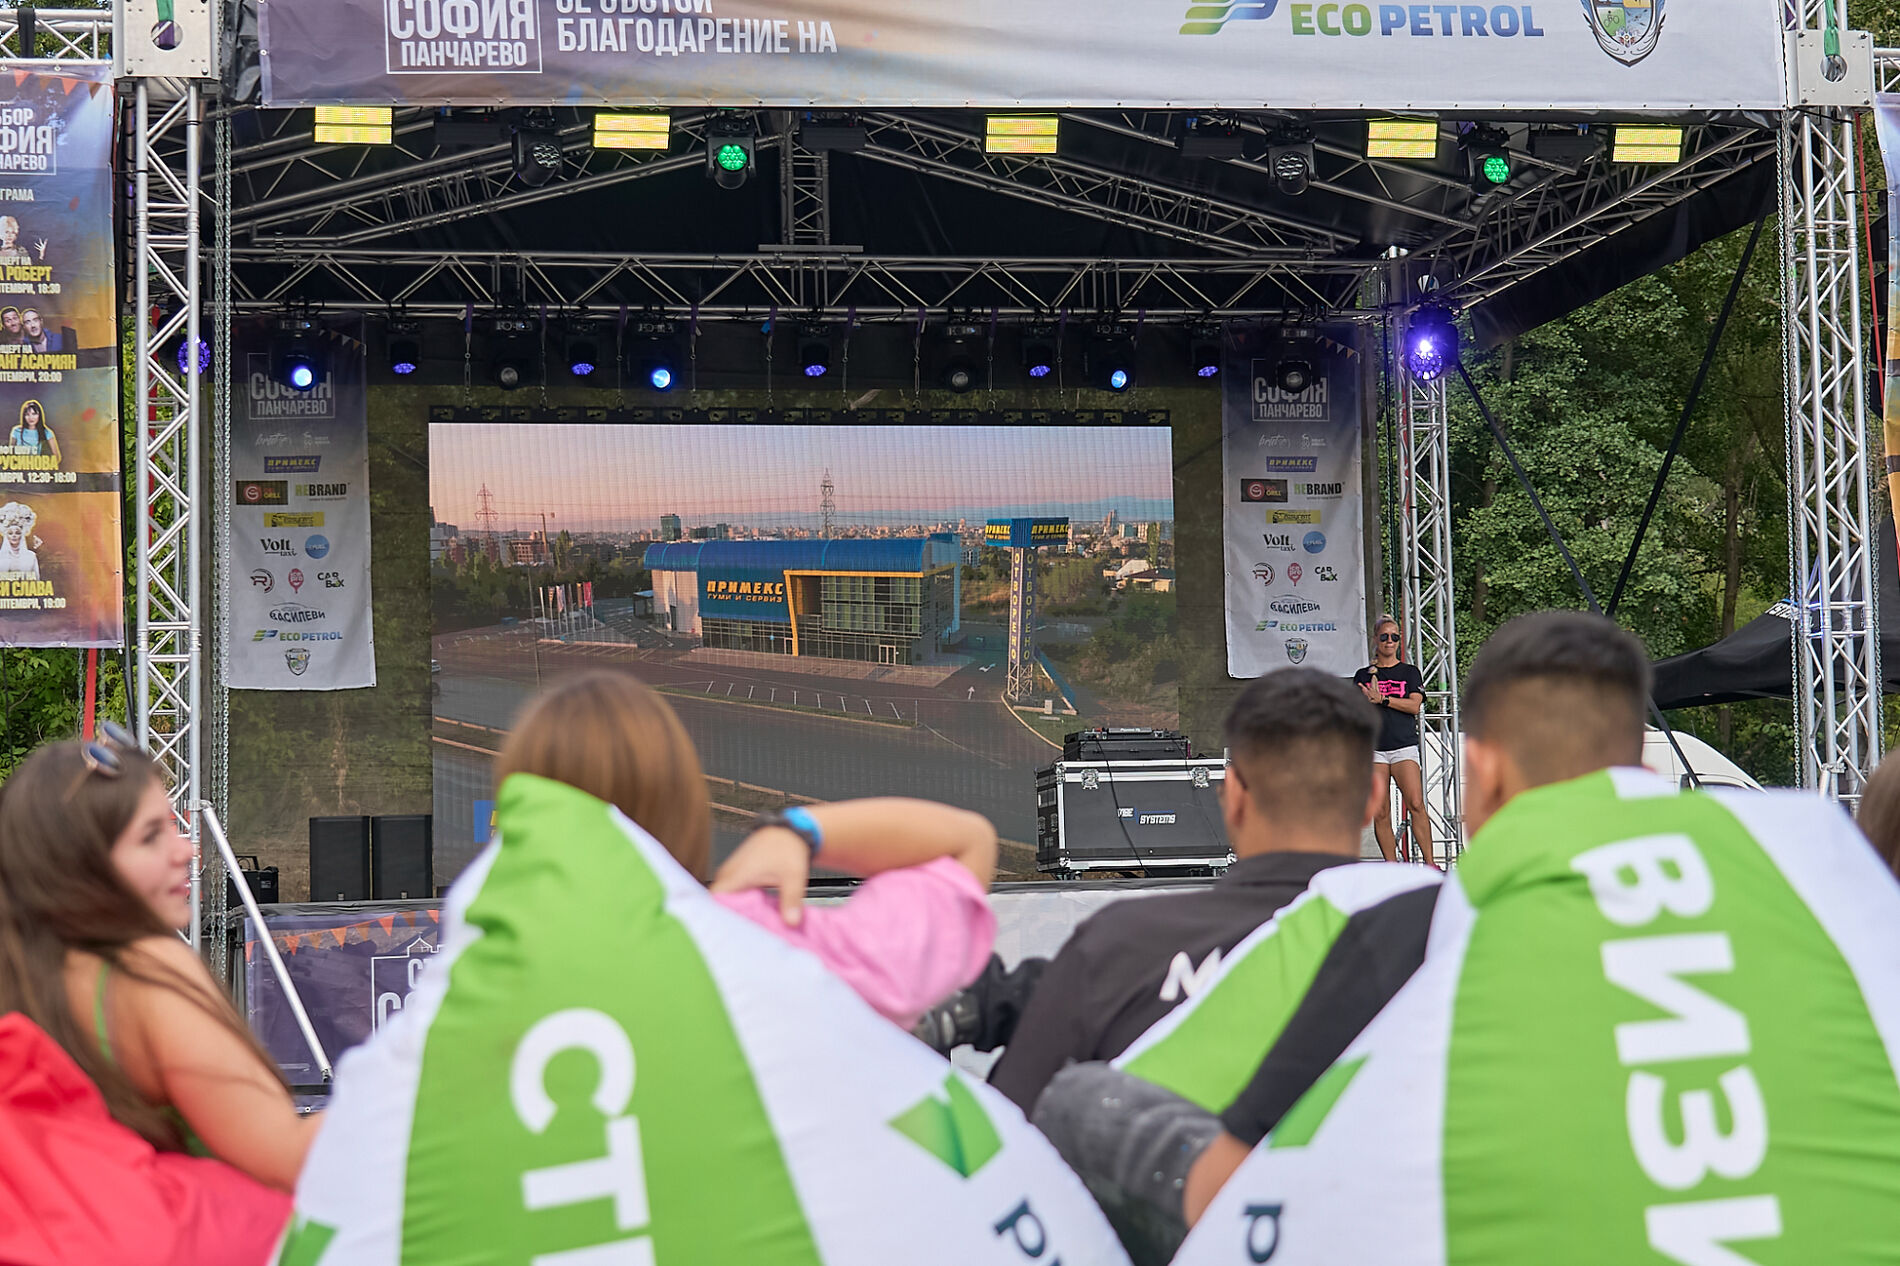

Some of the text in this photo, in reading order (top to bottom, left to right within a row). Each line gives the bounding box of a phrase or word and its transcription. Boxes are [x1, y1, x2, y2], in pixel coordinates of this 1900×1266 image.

[389, 0, 536, 40] СОФИЯ
[556, 18, 838, 57] БЛАГОДАРЕНИЕ НА
[401, 40, 528, 67] ПАНЧАРЕВО
[0, 107, 34, 126] БОР
[6, 265, 53, 282] РОБЕРТ
[38, 371, 62, 383] 20:00
[257, 400, 328, 416] ПАНЧАРЕВО
[1259, 403, 1323, 418] ПАНЧАРЕВО
[295, 483, 347, 497] REBRAND
[1294, 482, 1342, 495] REBRAND
[260, 538, 291, 551] Volt
[1263, 534, 1290, 546] Volt
[12, 580, 54, 597] СЛАВА
[706, 580, 784, 595] ПРИМЕКС
[746, 595, 783, 603] СЕРВИЗ
[1270, 600, 1321, 614] ВАСИЛЕВИ
[269, 608, 326, 623] ВАСИЛЕВИ
[510, 1007, 657, 1266] СТ
